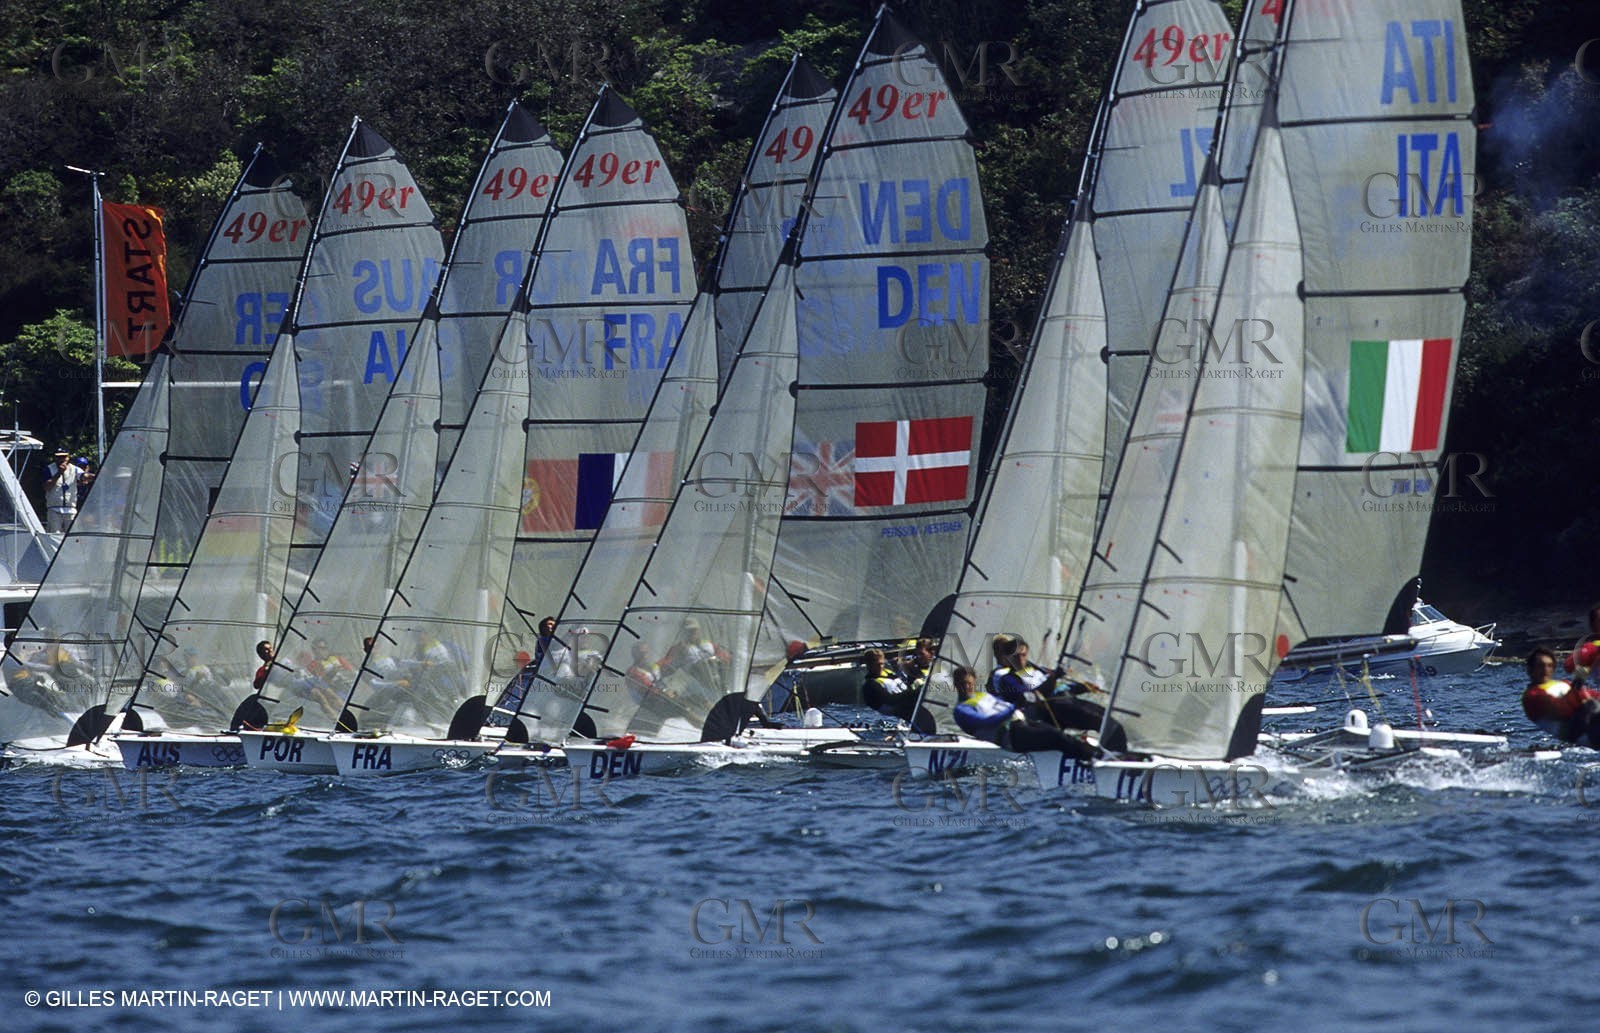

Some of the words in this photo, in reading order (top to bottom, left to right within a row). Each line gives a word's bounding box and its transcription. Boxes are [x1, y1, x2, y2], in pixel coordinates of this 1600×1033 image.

[1132, 25, 1230, 68] 49er
[847, 84, 948, 126] 49er
[765, 125, 814, 164] 49
[573, 152, 660, 188] 49er
[1397, 132, 1465, 218] ITA
[333, 180, 414, 215] 49er
[224, 211, 306, 244] 49er
[877, 261, 982, 330] DEN
[604, 312, 685, 371] FRA
[137, 741, 181, 767] AUS
[260, 736, 305, 763] POR
[352, 742, 393, 770] FRA
[590, 750, 643, 779] DEN
